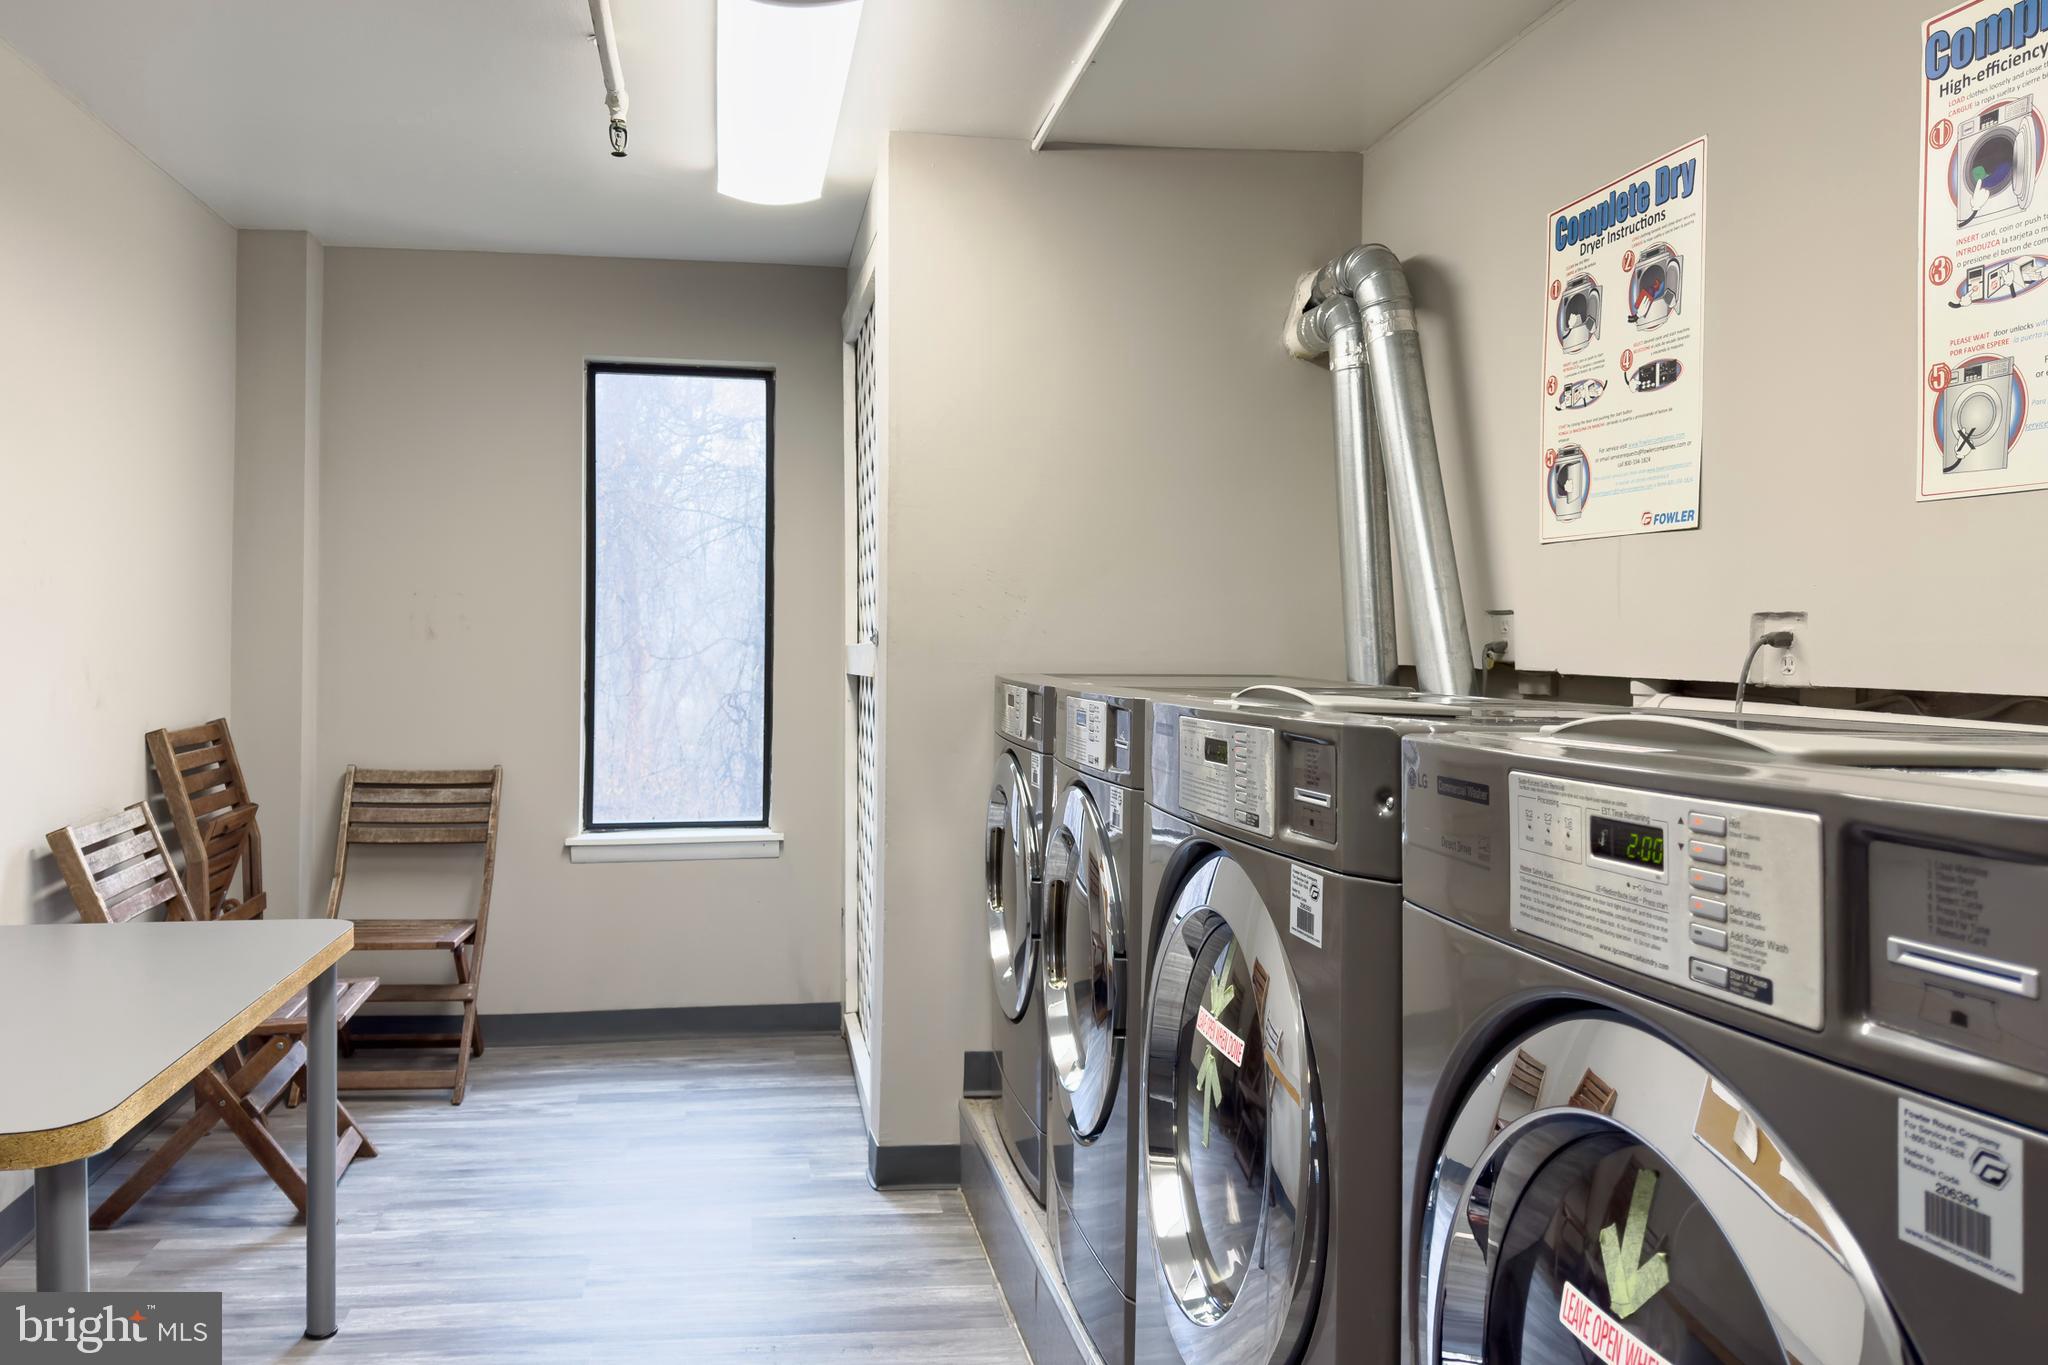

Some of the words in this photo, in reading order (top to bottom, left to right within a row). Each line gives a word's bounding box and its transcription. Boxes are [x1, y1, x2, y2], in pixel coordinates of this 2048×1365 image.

[1940, 42, 2048, 98] High-efficiency
[1948, 95, 1966, 108] LOAD
[1967, 87, 1988, 100] clothes
[1989, 76, 2011, 91] loosely
[2012, 70, 2025, 81] and
[1948, 103, 1974, 117] CARGUE
[1981, 94, 1996, 106] ropa
[1555, 181, 1650, 251] Complete
[1655, 158, 1696, 206] Dry
[1580, 235, 1604, 256] Dryer
[1607, 209, 1666, 245] Instructions
[1956, 233, 1979, 246] INSERT
[1999, 224, 2014, 234] coin
[2024, 215, 2042, 227] push
[1955, 239, 2001, 257] INTRODUZCA
[2001, 236, 2008, 244] la
[2009, 230, 2033, 242] tarjeta
[1963, 254, 1991, 268] presione
[2000, 245, 2021, 256] boton
[2022, 241, 2032, 250] de
[1950, 335, 1972, 346] PLEASE
[1973, 331, 1990, 343] WAIT
[1994, 328, 2008, 337] door
[2010, 322, 2034, 333] unlocks
[1950, 347, 1963, 357] POR
[1964, 343, 1985, 355] FAVOR
[1987, 338, 2010, 350] ESPERE
[1653, 509, 1695, 526] FOWLER
[1417, 773, 1428, 789] LG
[1729, 848, 1750, 860] Warm
[1729, 876, 1744, 888] Cold
[1729, 905, 1761, 921] Delicates
[1730, 931, 1744, 943] Add
[1744, 934, 1766, 949] Super
[1767, 939, 1789, 954] Wash
[1904, 1119, 1917, 1130] For
[1563, 1287, 1593, 1340] LEAVE
[1591, 1314, 1624, 1365] OPEN
